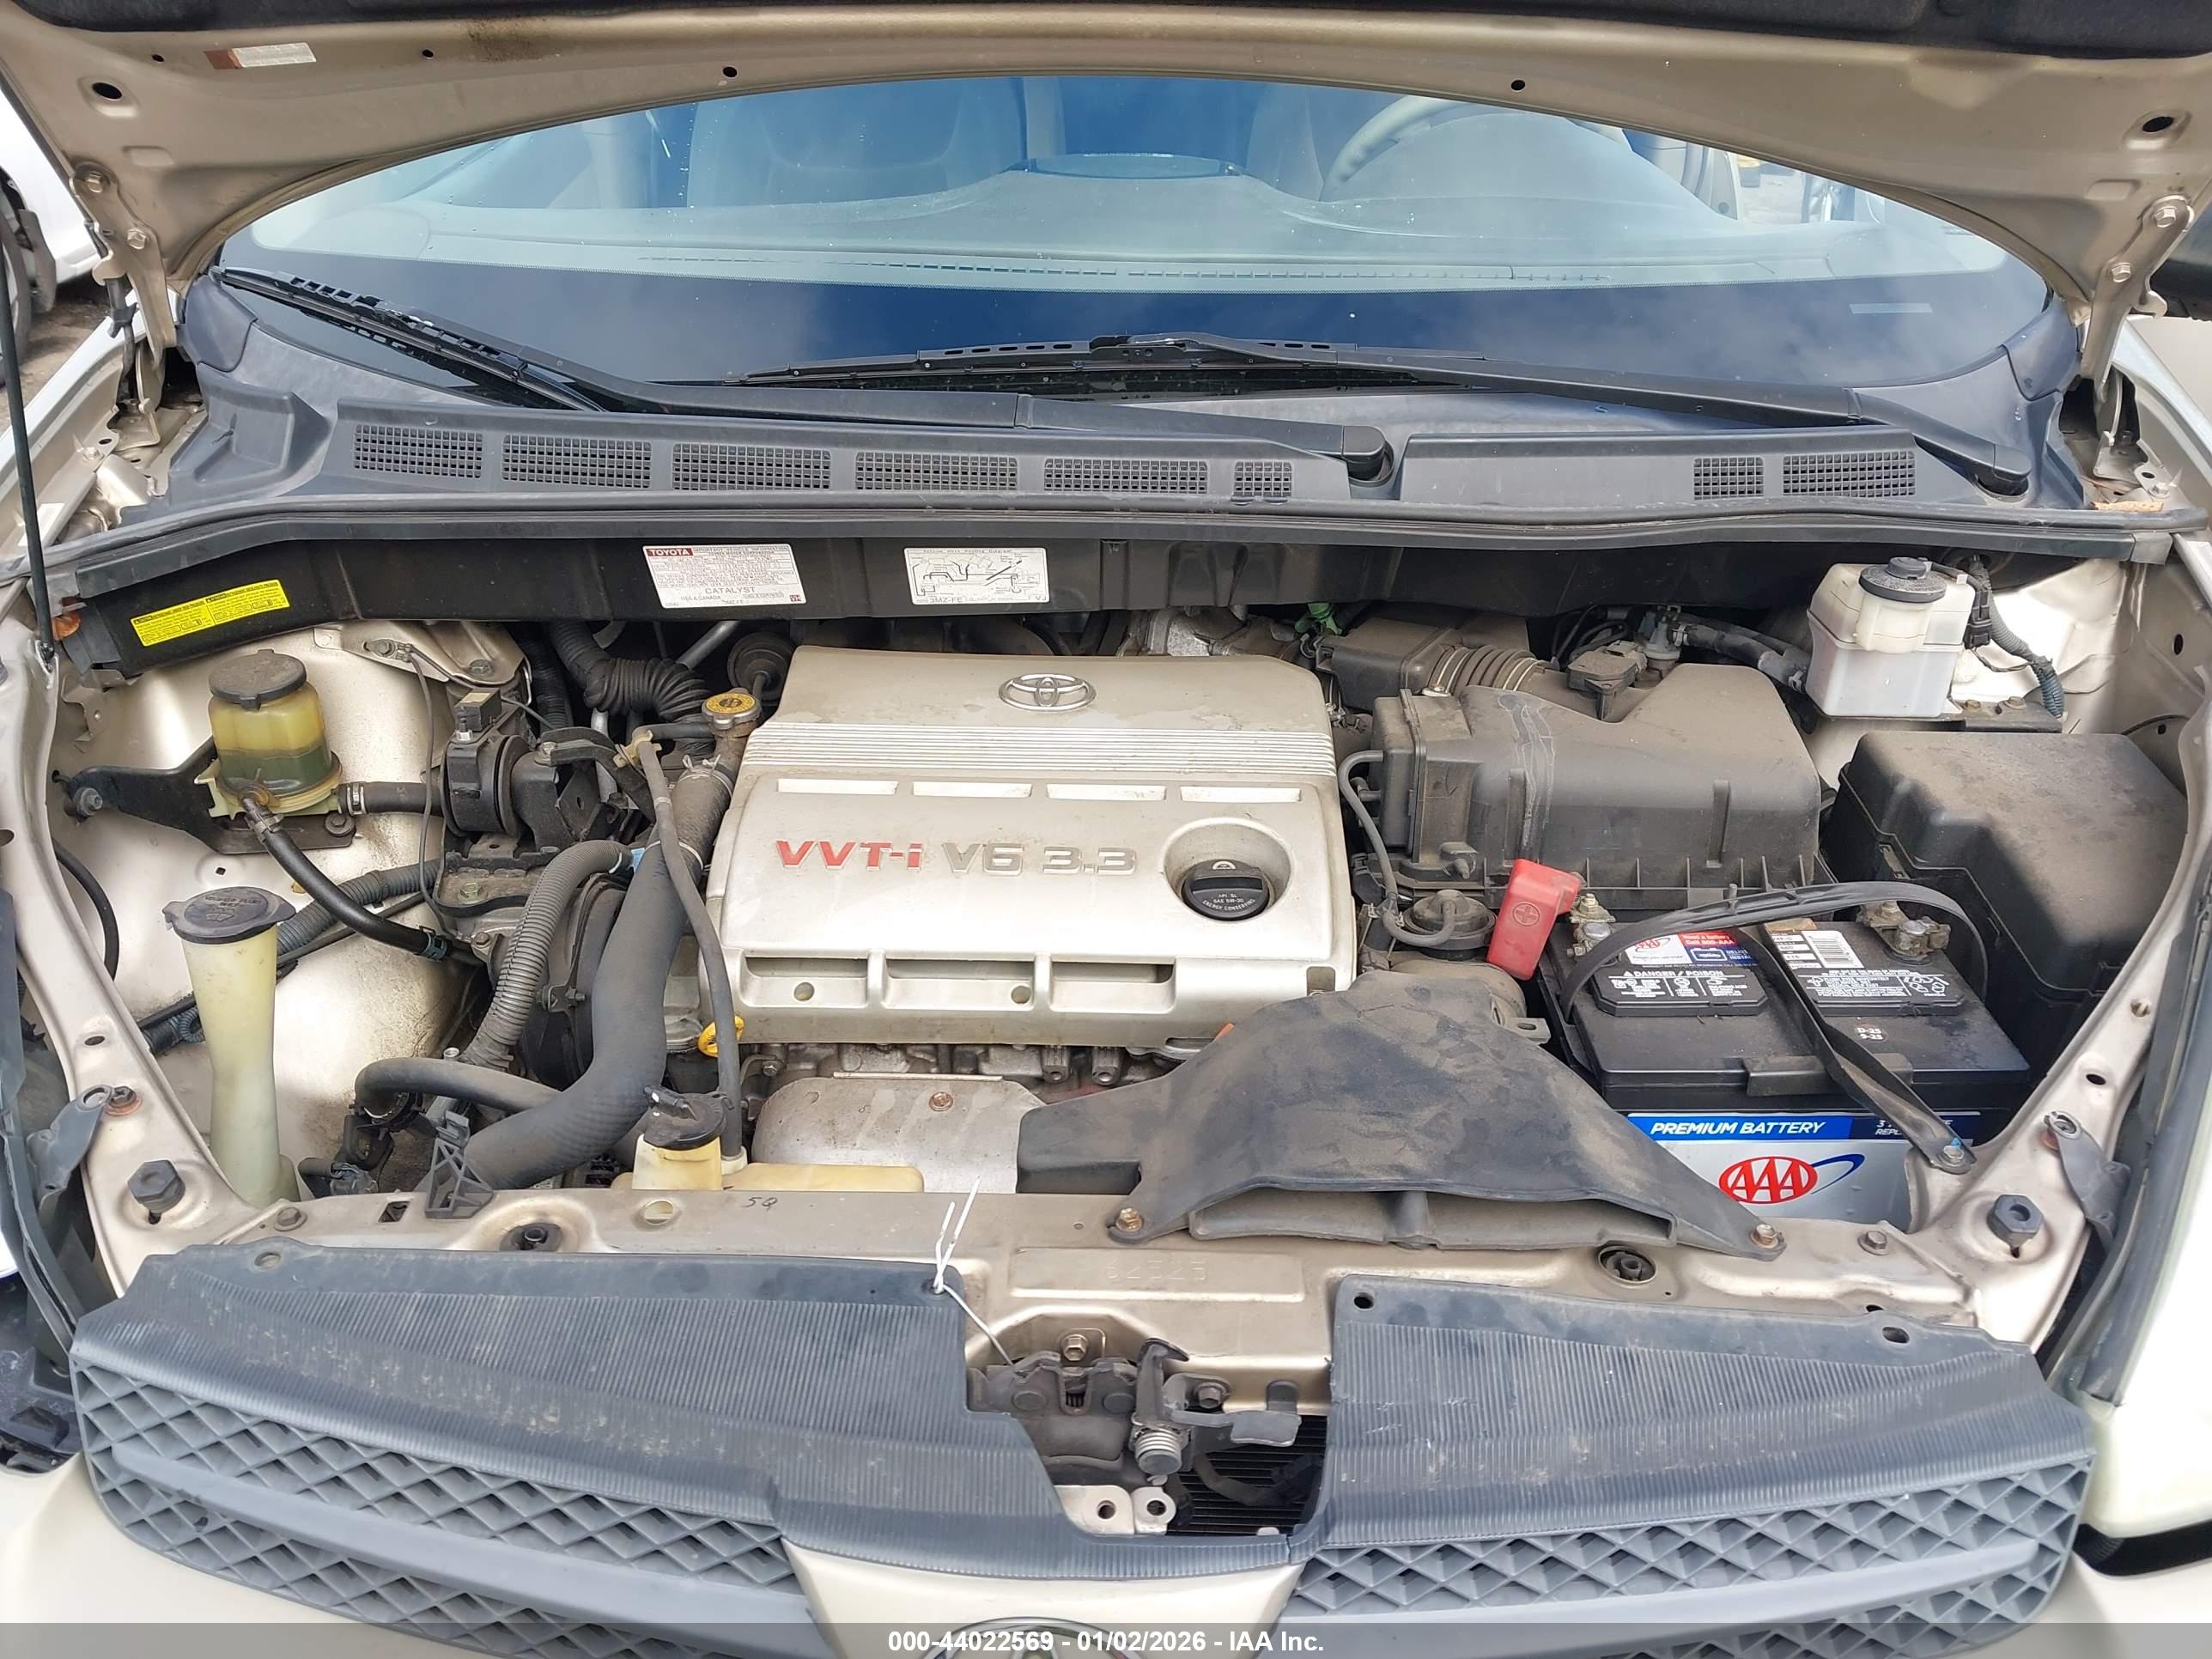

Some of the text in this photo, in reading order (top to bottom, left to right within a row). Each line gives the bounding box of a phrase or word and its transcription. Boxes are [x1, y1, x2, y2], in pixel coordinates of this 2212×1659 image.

[775, 840, 925, 871] VVT-i
[941, 842, 1137, 876] V6 3.3
[1650, 1121, 1826, 1134] PREMIUM BATTERY
[1724, 1157, 1812, 1203] AAA
